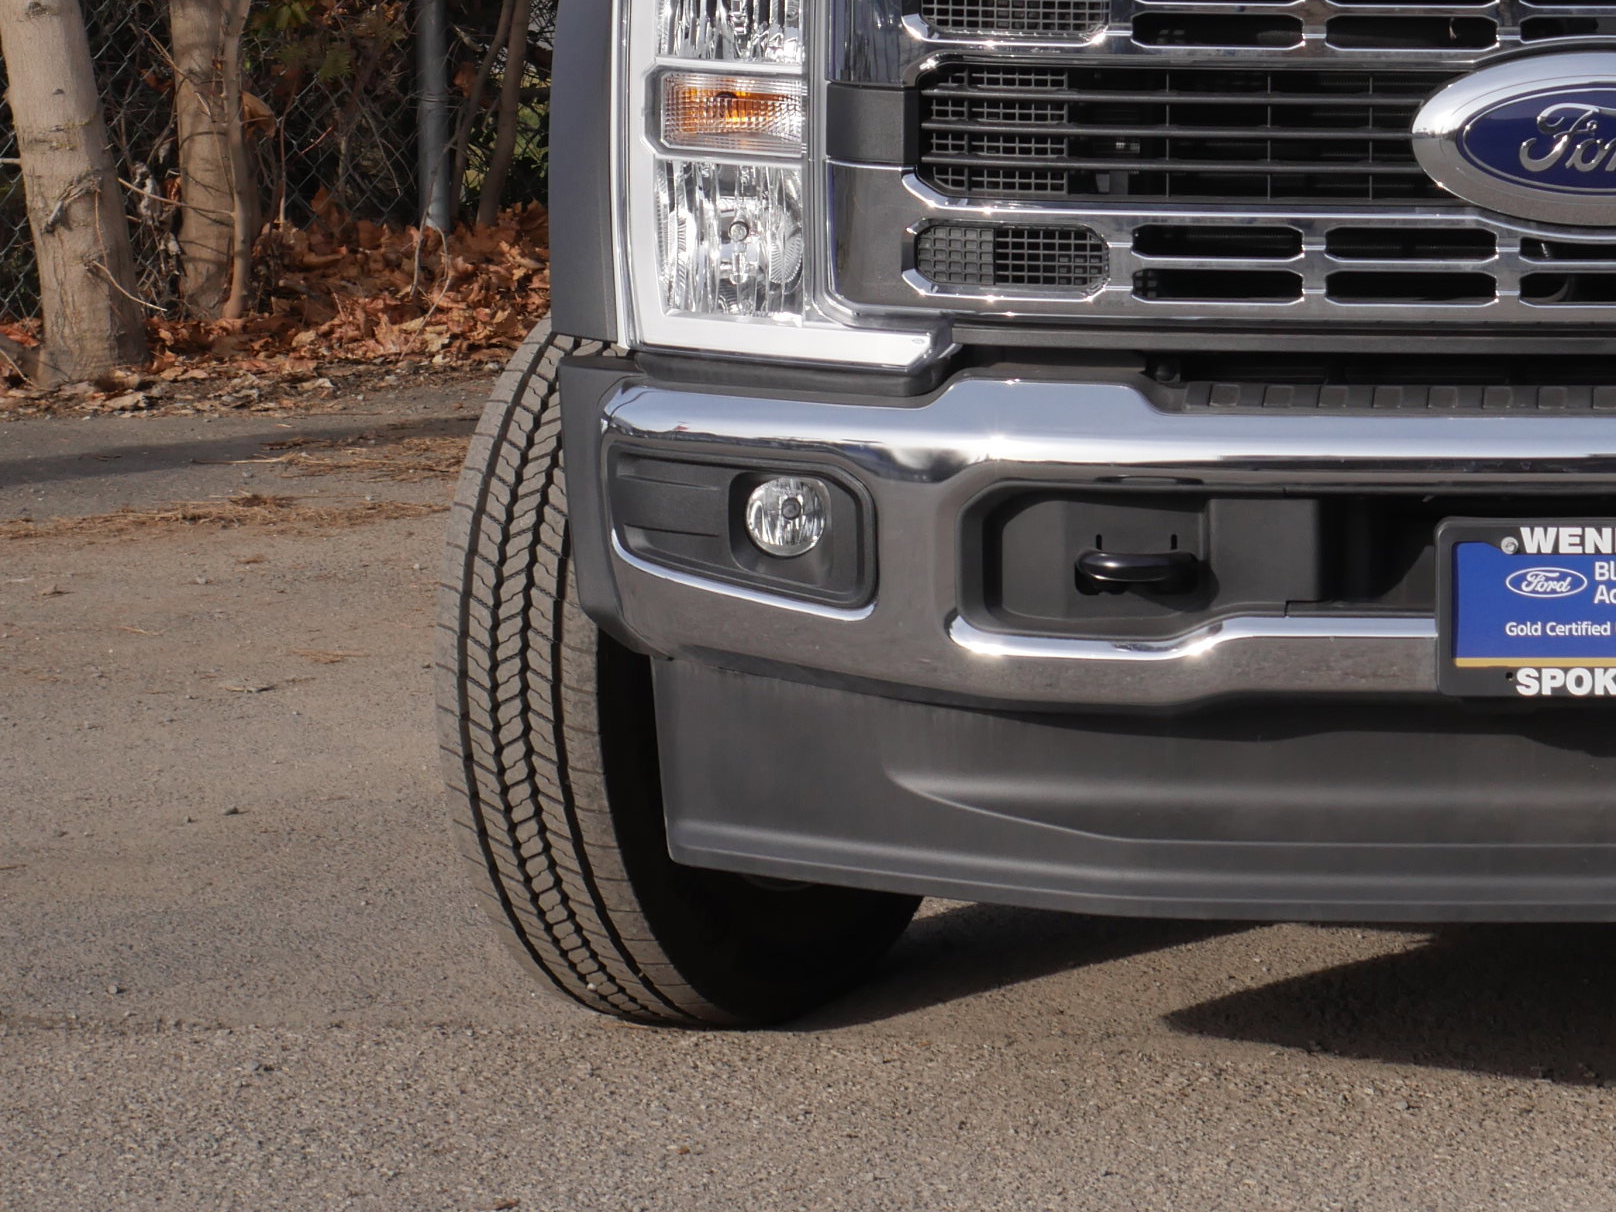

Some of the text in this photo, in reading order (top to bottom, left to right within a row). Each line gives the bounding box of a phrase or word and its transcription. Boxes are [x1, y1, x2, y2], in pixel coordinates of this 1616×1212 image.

[1521, 571, 1572, 592] Ford
[1505, 621, 1541, 636] Gold
[1546, 621, 1611, 636] Certified
